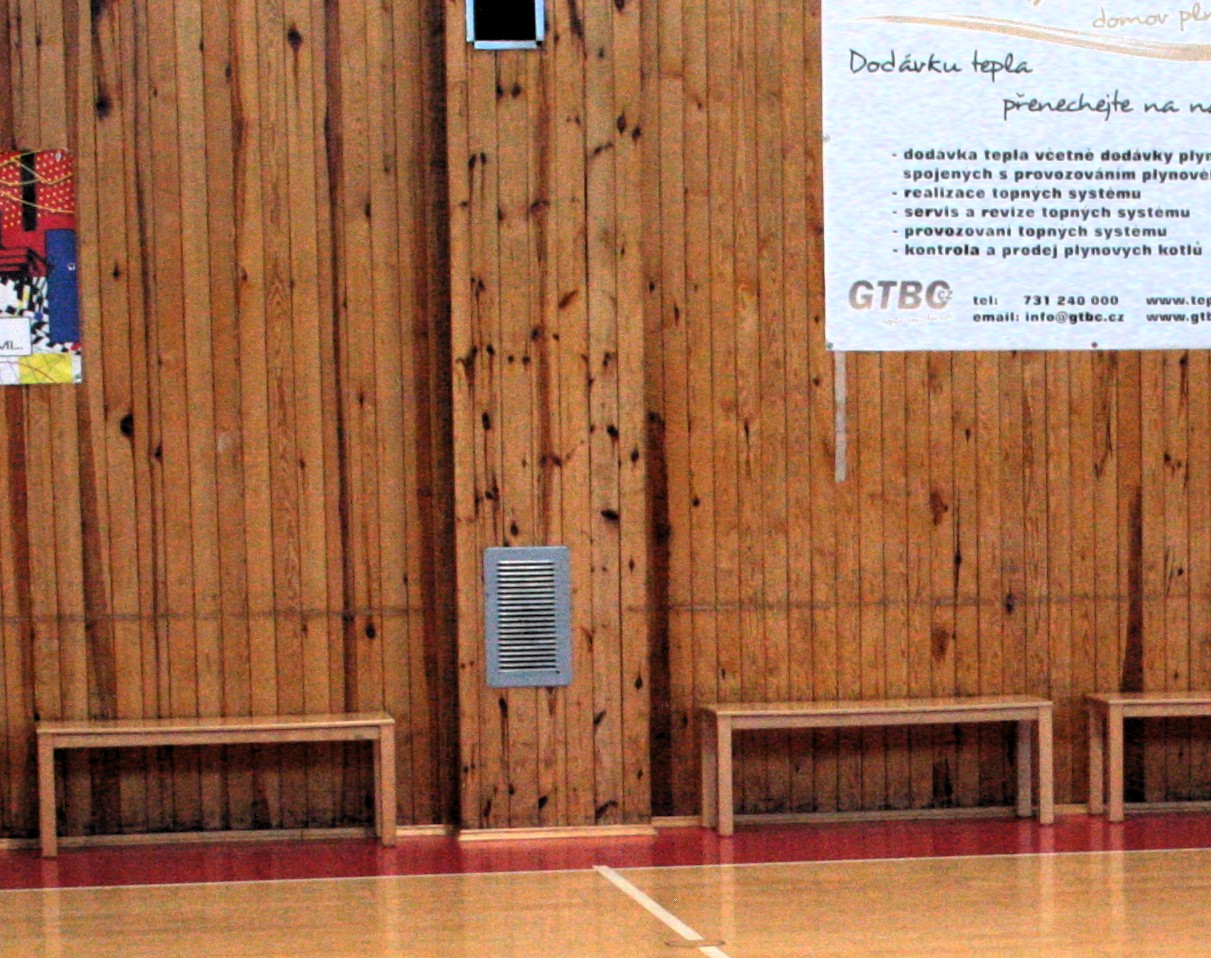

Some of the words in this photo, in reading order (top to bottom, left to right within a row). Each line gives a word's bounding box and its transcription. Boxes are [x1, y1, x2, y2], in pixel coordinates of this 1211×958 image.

[1092, 9, 1169, 28] domov
[849, 48, 962, 74] Dodávku
[970, 48, 1034, 82] tepla
[1001, 88, 1136, 123] přenechejte
[1143, 100, 1180, 114] na
[984, 148, 1029, 164] tepla
[998, 170, 1008, 180] s
[903, 186, 986, 199] realizace
[904, 205, 959, 218] servis
[965, 208, 975, 218] a
[981, 206, 1035, 218] revize
[904, 243, 980, 256] kontrola
[986, 246, 996, 256] a
[1001, 243, 1058, 260] prodej
[1157, 241, 1203, 256] kotlů
[848, 280, 952, 310] GTBC
[972, 295, 998, 306] tel:
[1023, 294, 1050, 306] 731
[1056, 295, 1086, 306] 240
[1090, 294, 1119, 306] 000
[972, 311, 1020, 323] email:
[1024, 310, 1125, 325] info@gtbc.cz
